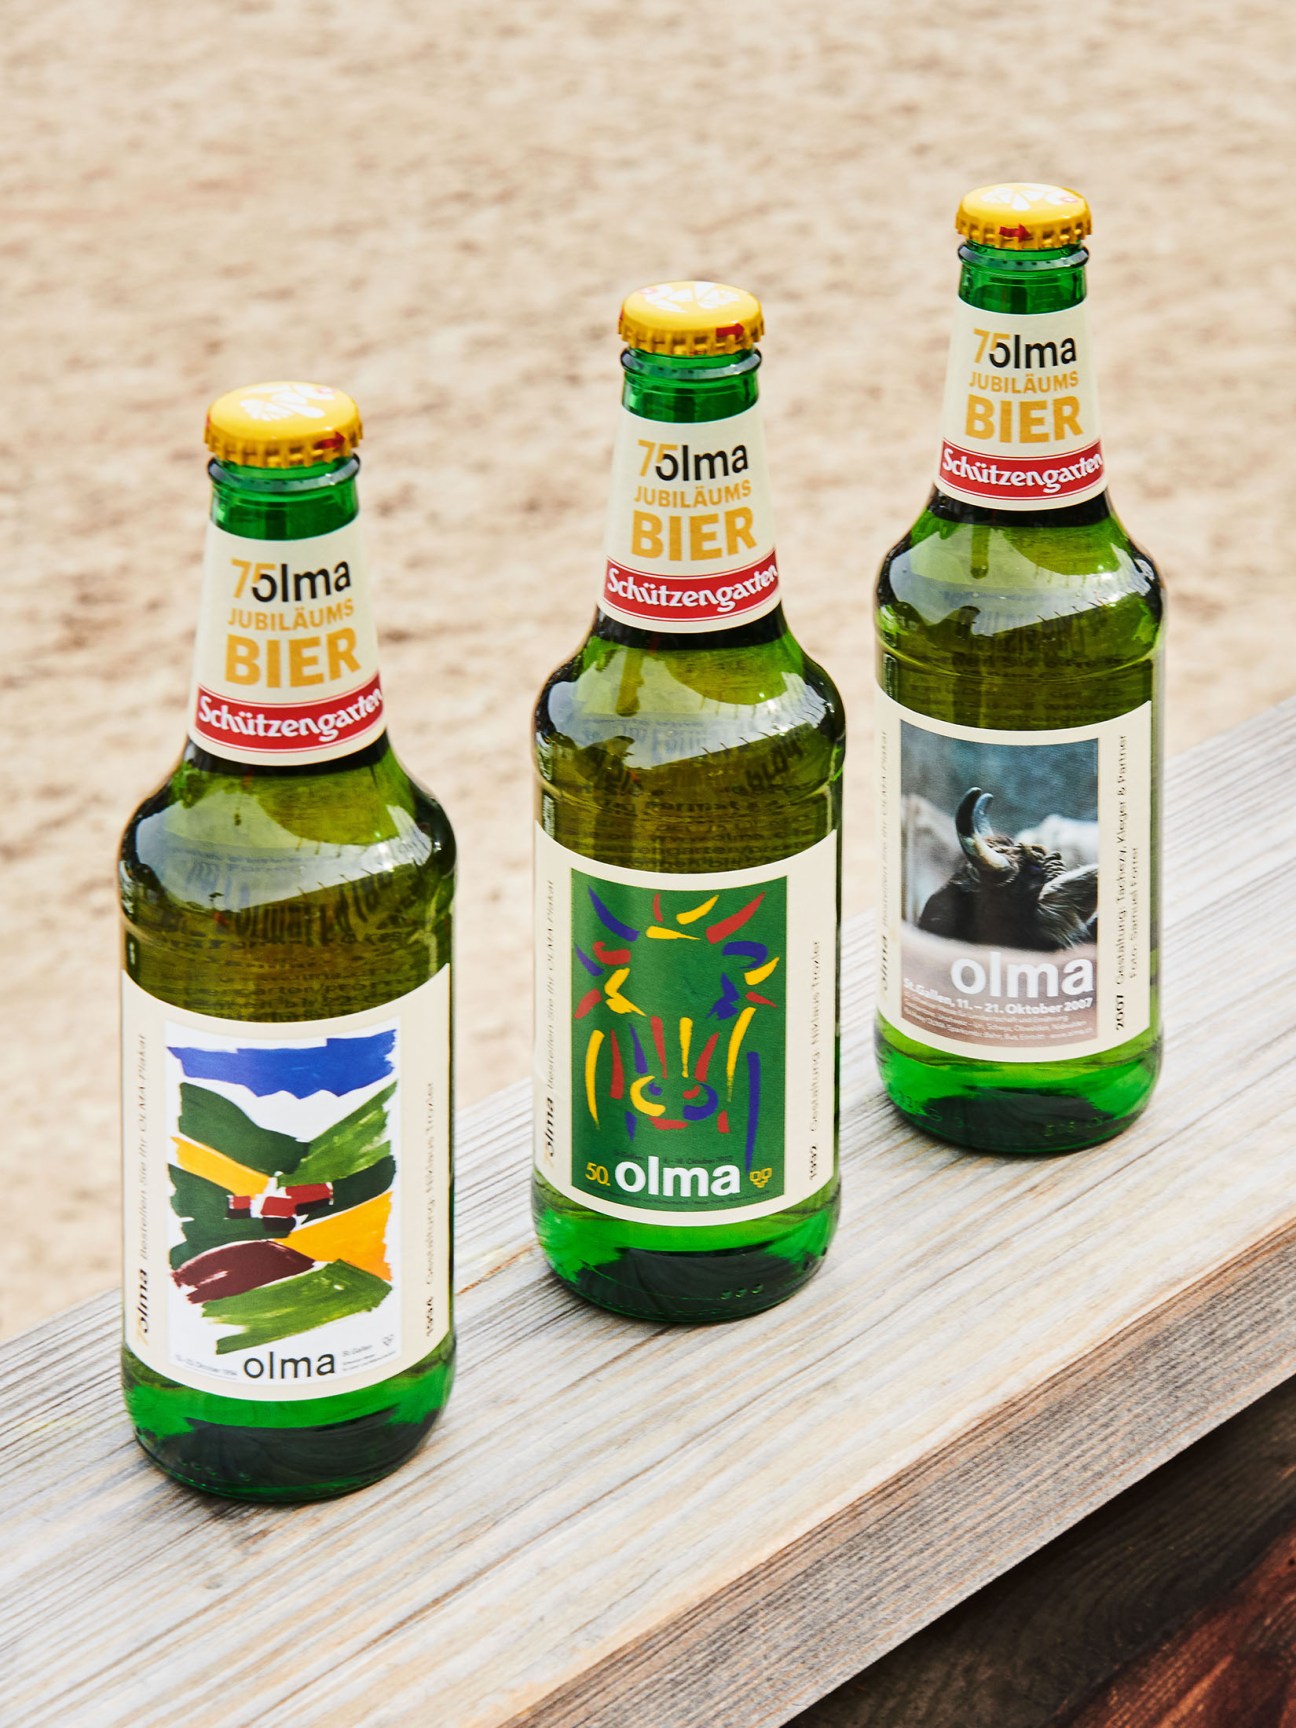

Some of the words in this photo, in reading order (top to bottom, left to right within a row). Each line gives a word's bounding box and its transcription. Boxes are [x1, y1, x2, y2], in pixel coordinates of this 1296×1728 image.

[969, 370, 1079, 394] JUBILÄUMS
[965, 393, 1084, 443] BIER
[633, 479, 752, 509] JUBILÄUMS
[942, 448, 1103, 494] Schützengarten
[631, 506, 758, 562] BIER
[607, 564, 779, 613] Schützengarten
[227, 598, 355, 631] JUBILÄUMS
[224, 627, 361, 688] BIER
[198, 687, 384, 742] Schützengarten
[951, 951, 1094, 998] olma
[1005, 1002, 1063, 1014] Oktober
[1063, 997, 1093, 1012] 2007
[614, 1155, 741, 1198] olma
[243, 1350, 336, 1380] olma
